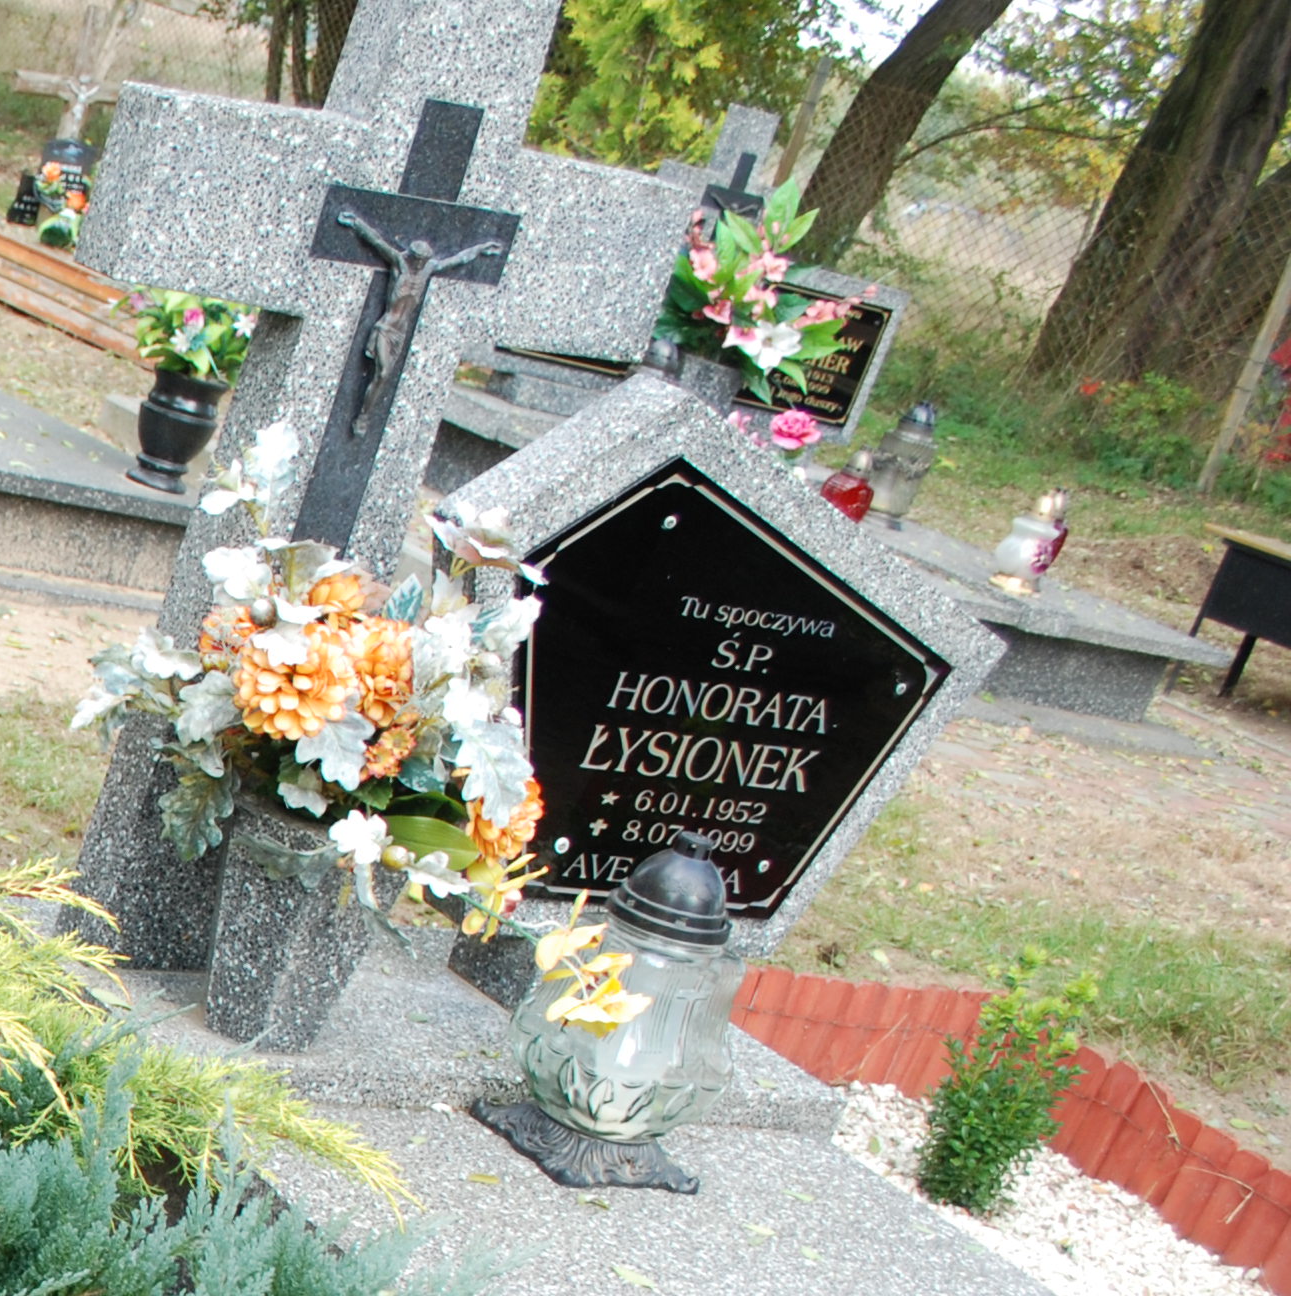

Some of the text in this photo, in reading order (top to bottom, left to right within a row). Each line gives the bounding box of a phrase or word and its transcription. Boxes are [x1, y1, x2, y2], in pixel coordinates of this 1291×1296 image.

[680, 596, 836, 639] Tu spoczywa
[710, 632, 774, 675] Ś.P.
[607, 671, 829, 735] HONORATA
[580, 725, 820, 794] ŁYSIONEK
[634, 789, 768, 825] 6.01.1952
[622, 819, 756, 855] 8.07999
[562, 853, 634, 883] AVE
